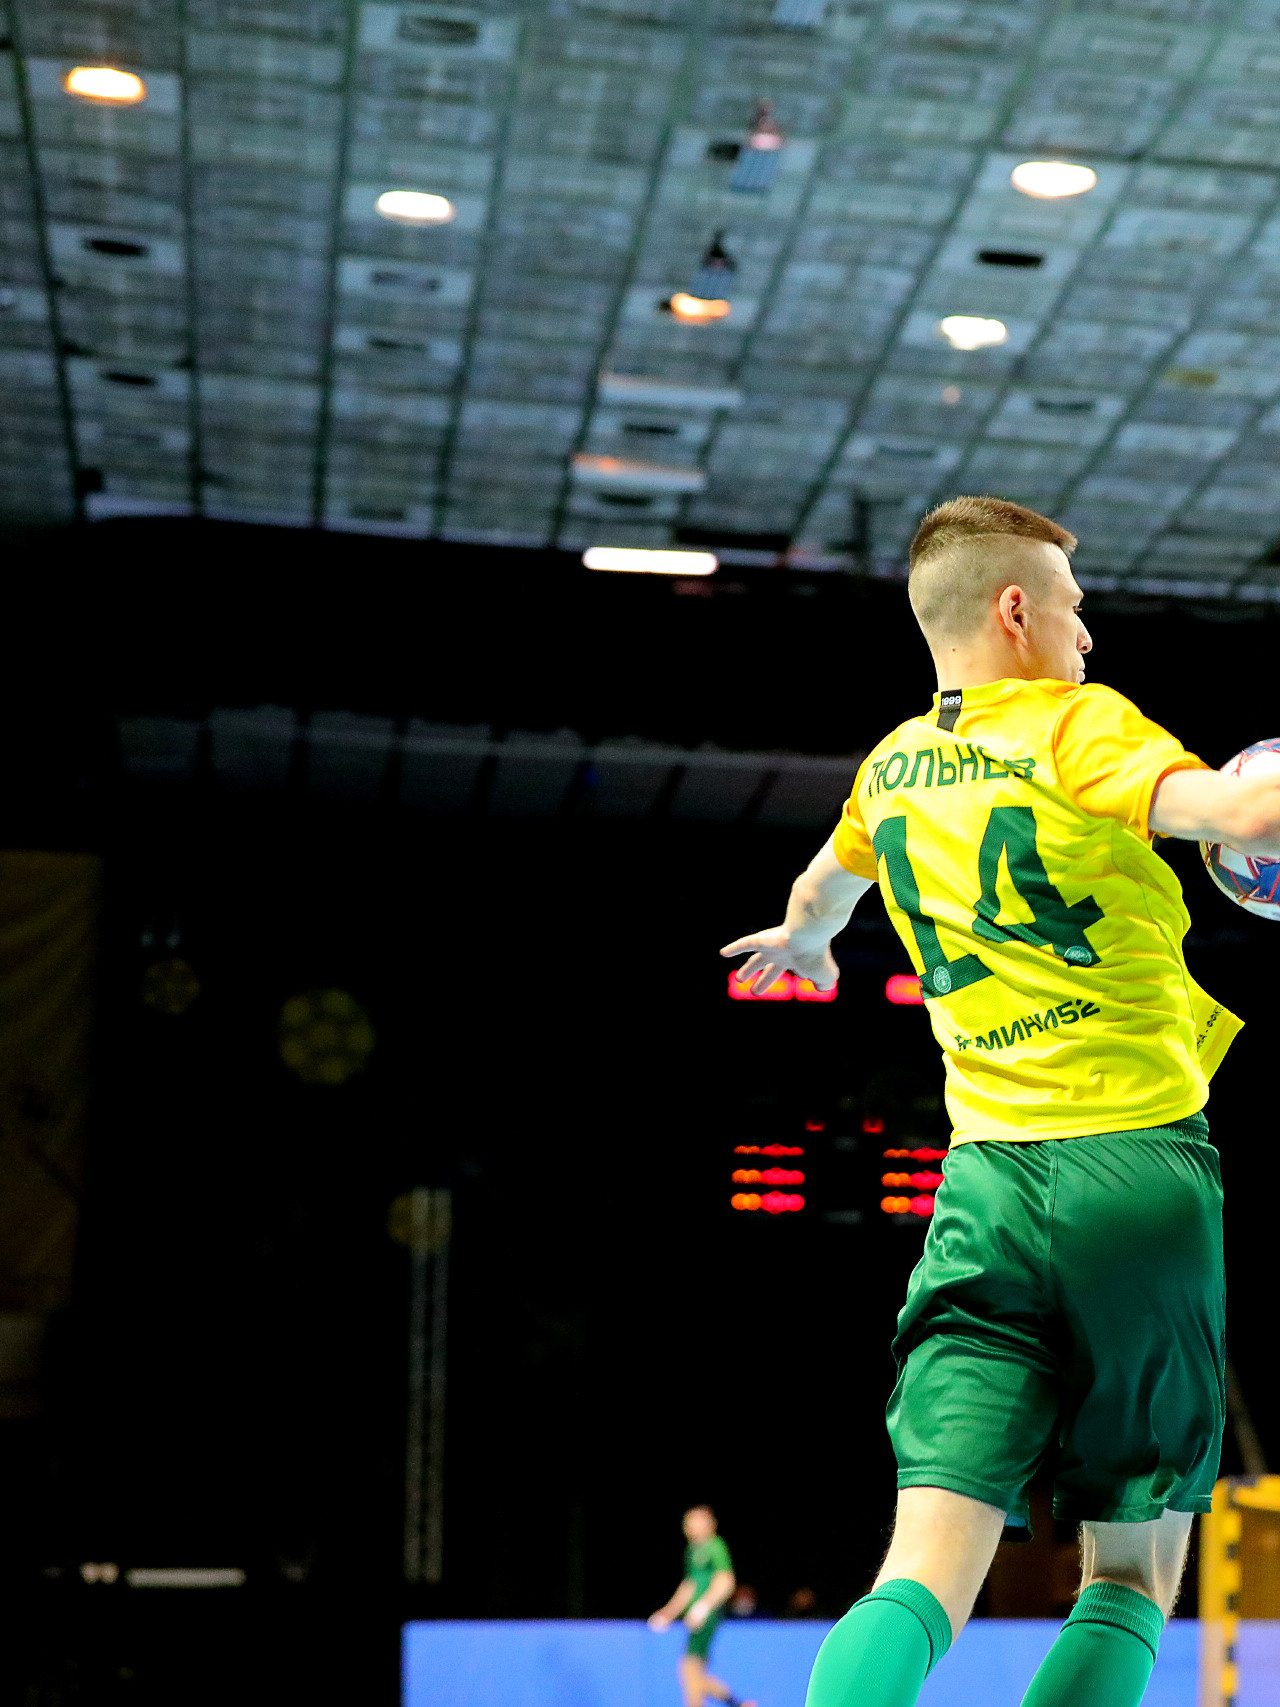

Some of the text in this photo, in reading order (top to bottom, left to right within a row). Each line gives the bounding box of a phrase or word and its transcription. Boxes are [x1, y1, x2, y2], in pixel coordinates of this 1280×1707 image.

[941, 695, 962, 706] 1999
[868, 743, 1037, 798] ТЮЛЬНЕВ
[872, 806, 1105, 1000] 14
